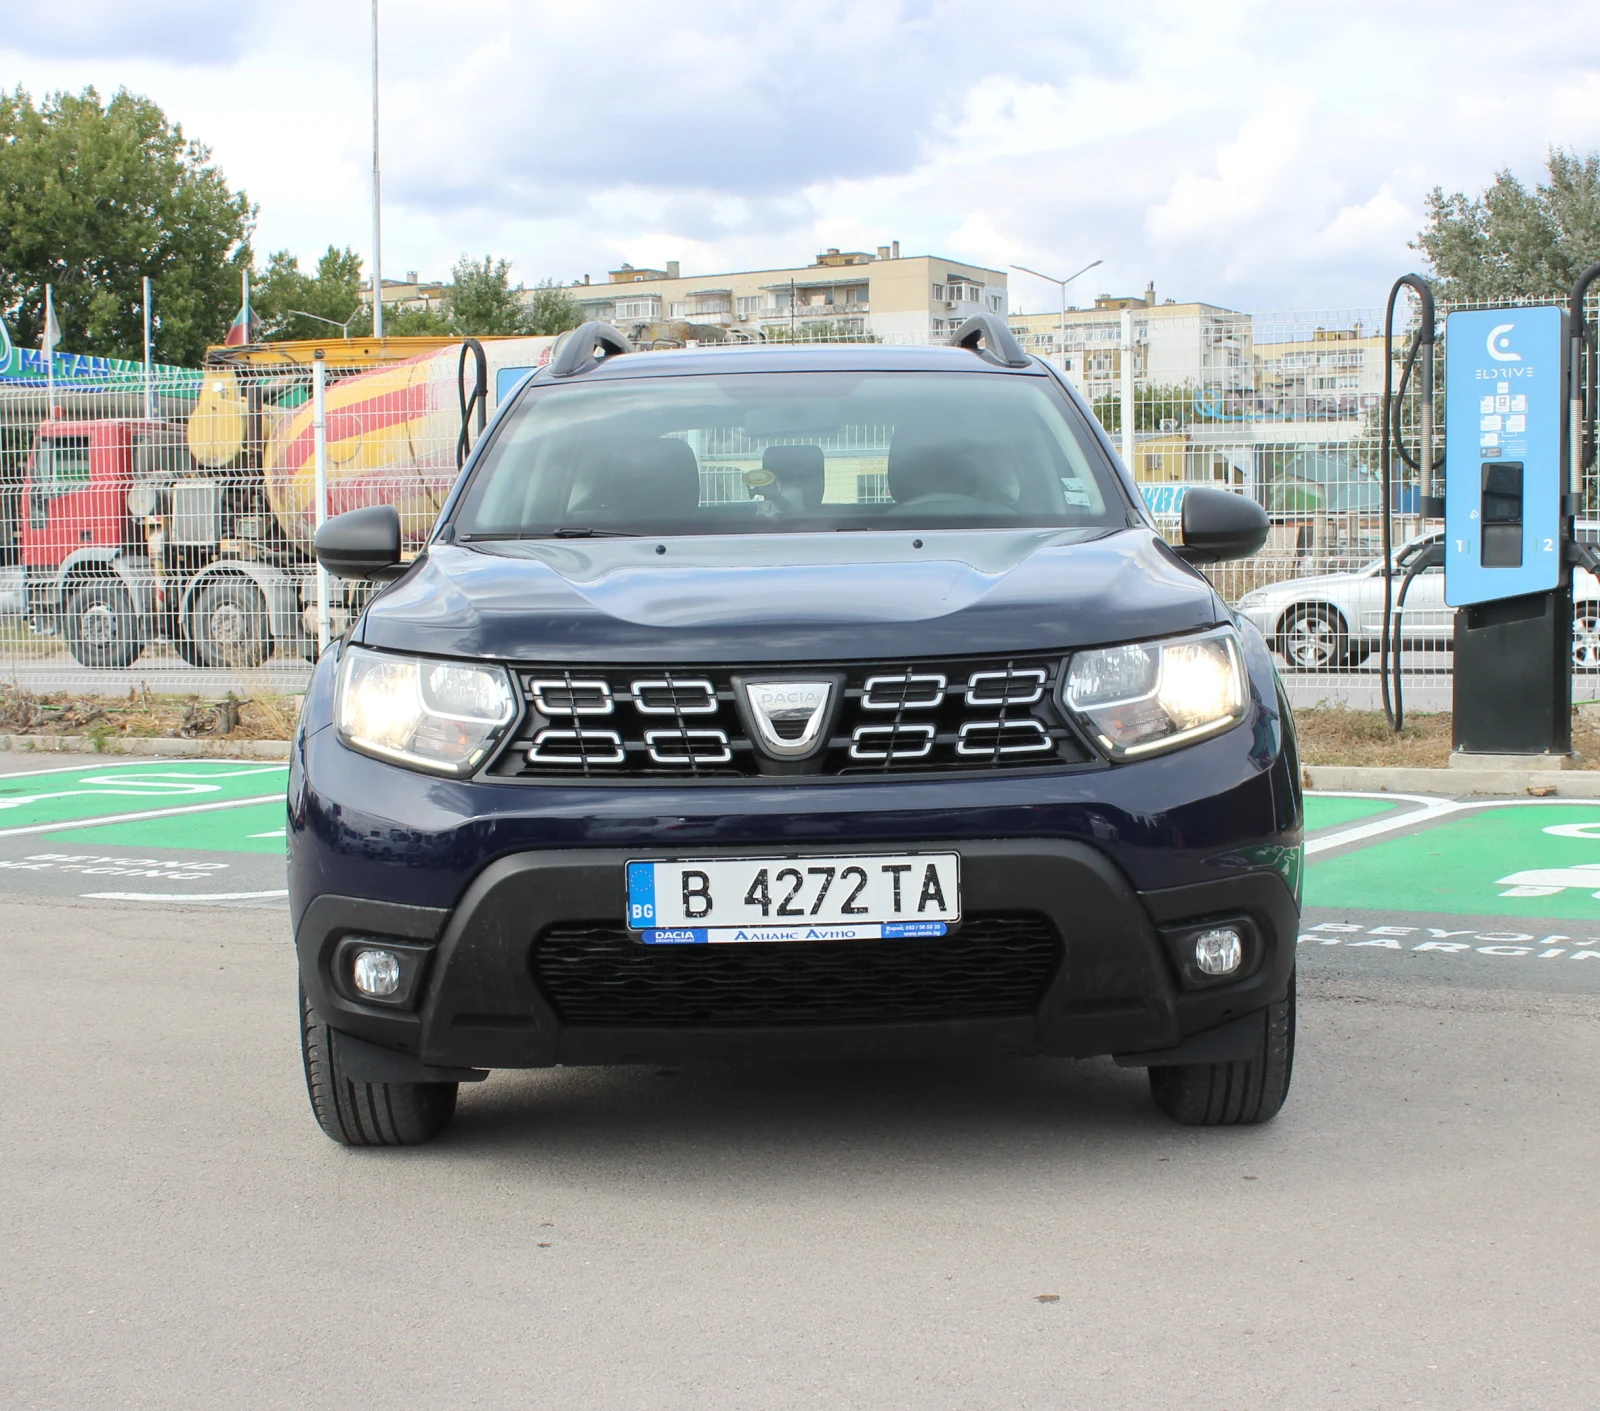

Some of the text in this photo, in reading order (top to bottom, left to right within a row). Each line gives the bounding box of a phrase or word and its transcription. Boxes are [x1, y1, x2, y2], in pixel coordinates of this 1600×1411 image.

[1475, 367, 1533, 379] ELDRIVE
[1456, 540, 1463, 552] 1
[1543, 539, 1553, 551] 2
[762, 693, 817, 703] DACIA
[681, 863, 947, 918] B 4272 TA
[632, 904, 653, 919] BG
[655, 931, 694, 939] DACIA
